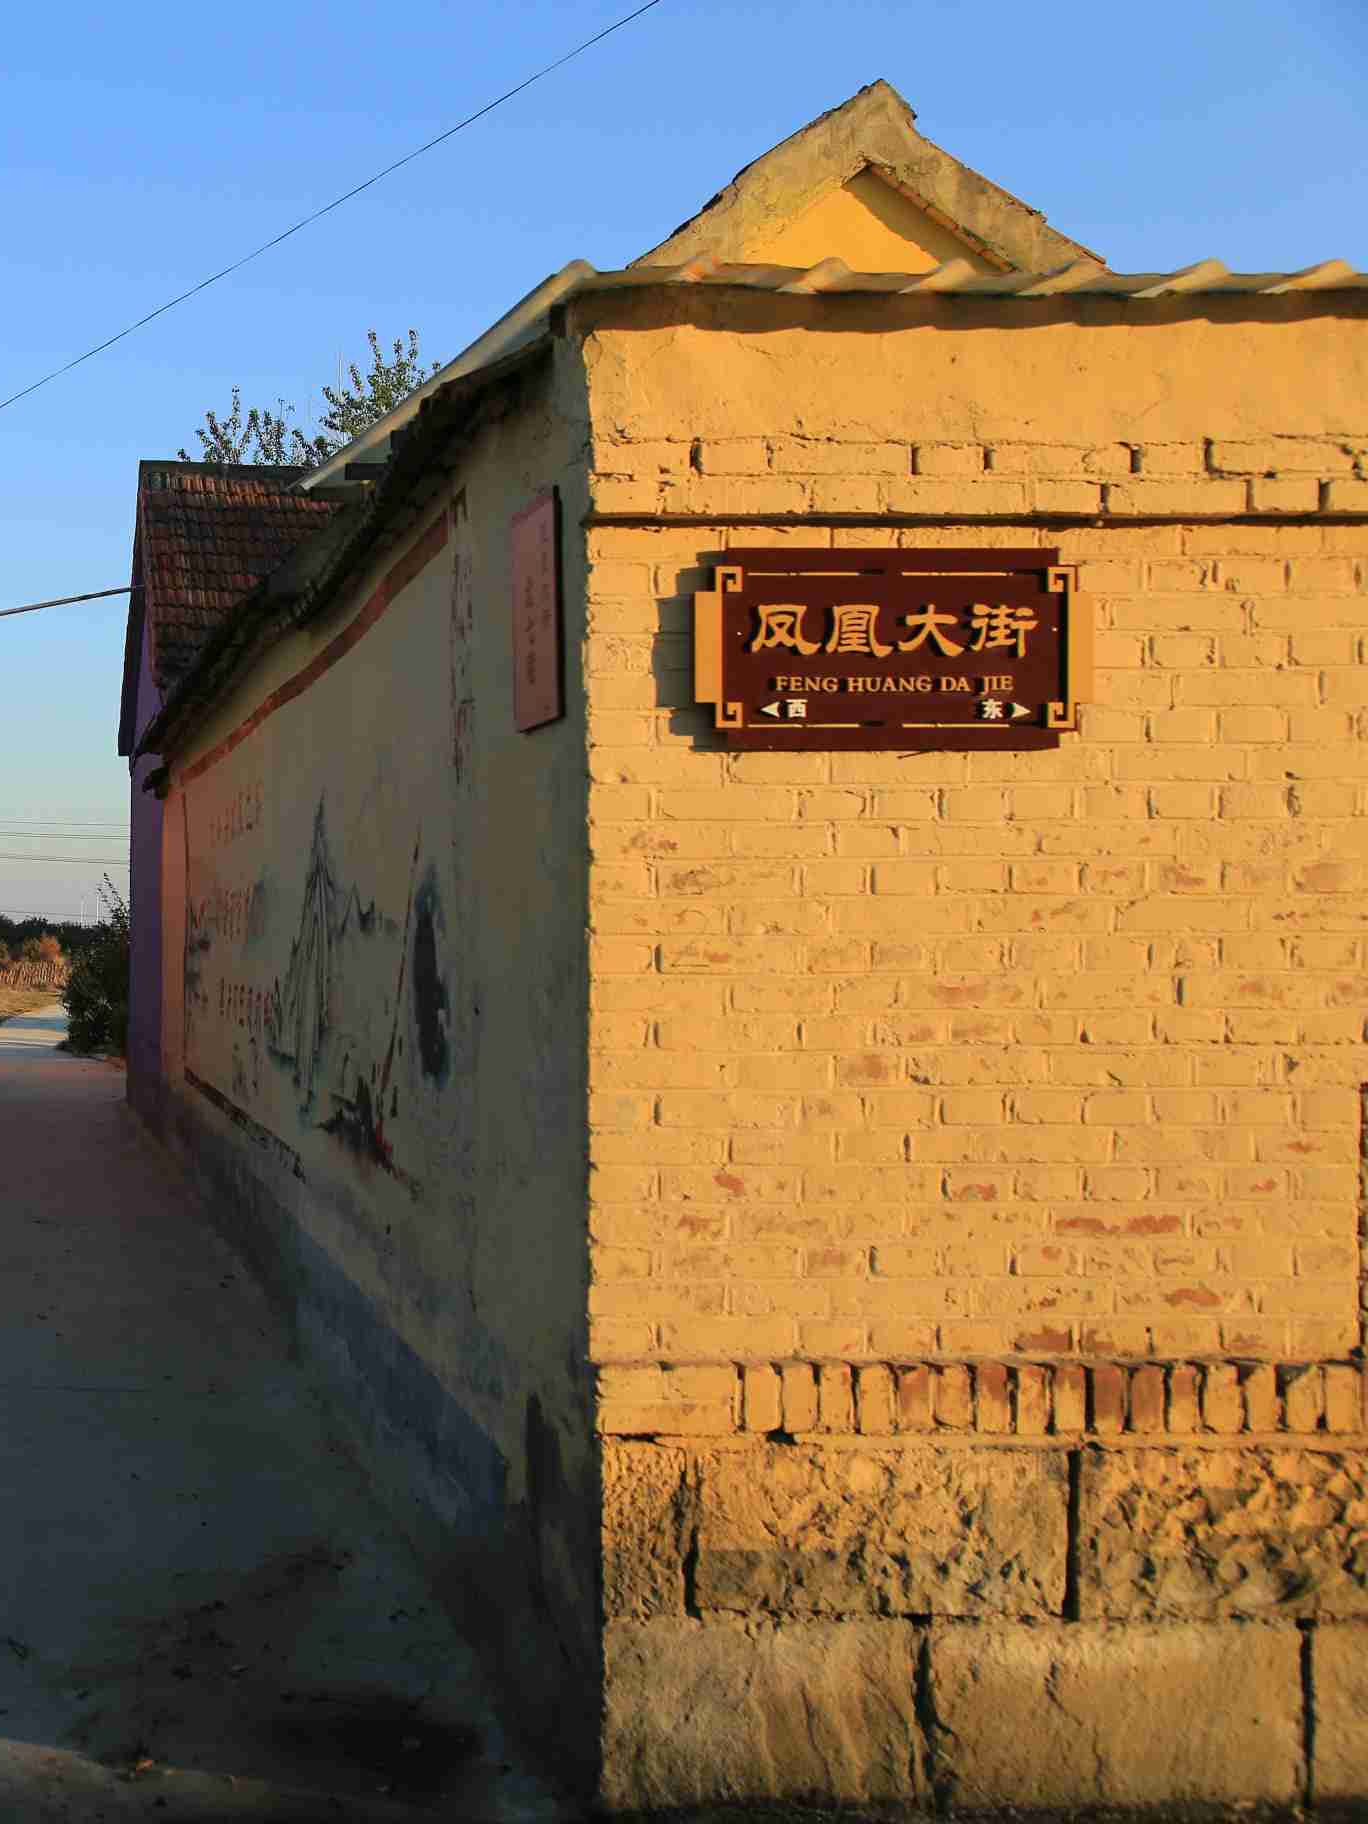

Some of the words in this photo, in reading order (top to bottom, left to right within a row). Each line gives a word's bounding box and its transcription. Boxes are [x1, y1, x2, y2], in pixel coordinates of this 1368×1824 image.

[751, 603, 1039, 657] 凤凰大街
[775, 675, 839, 693] FENG
[847, 675, 933, 693] HUANG
[940, 676, 971, 693] DA
[982, 675, 1014, 695] JIE
[786, 698, 808, 719] 西
[982, 698, 1004, 719] 东
